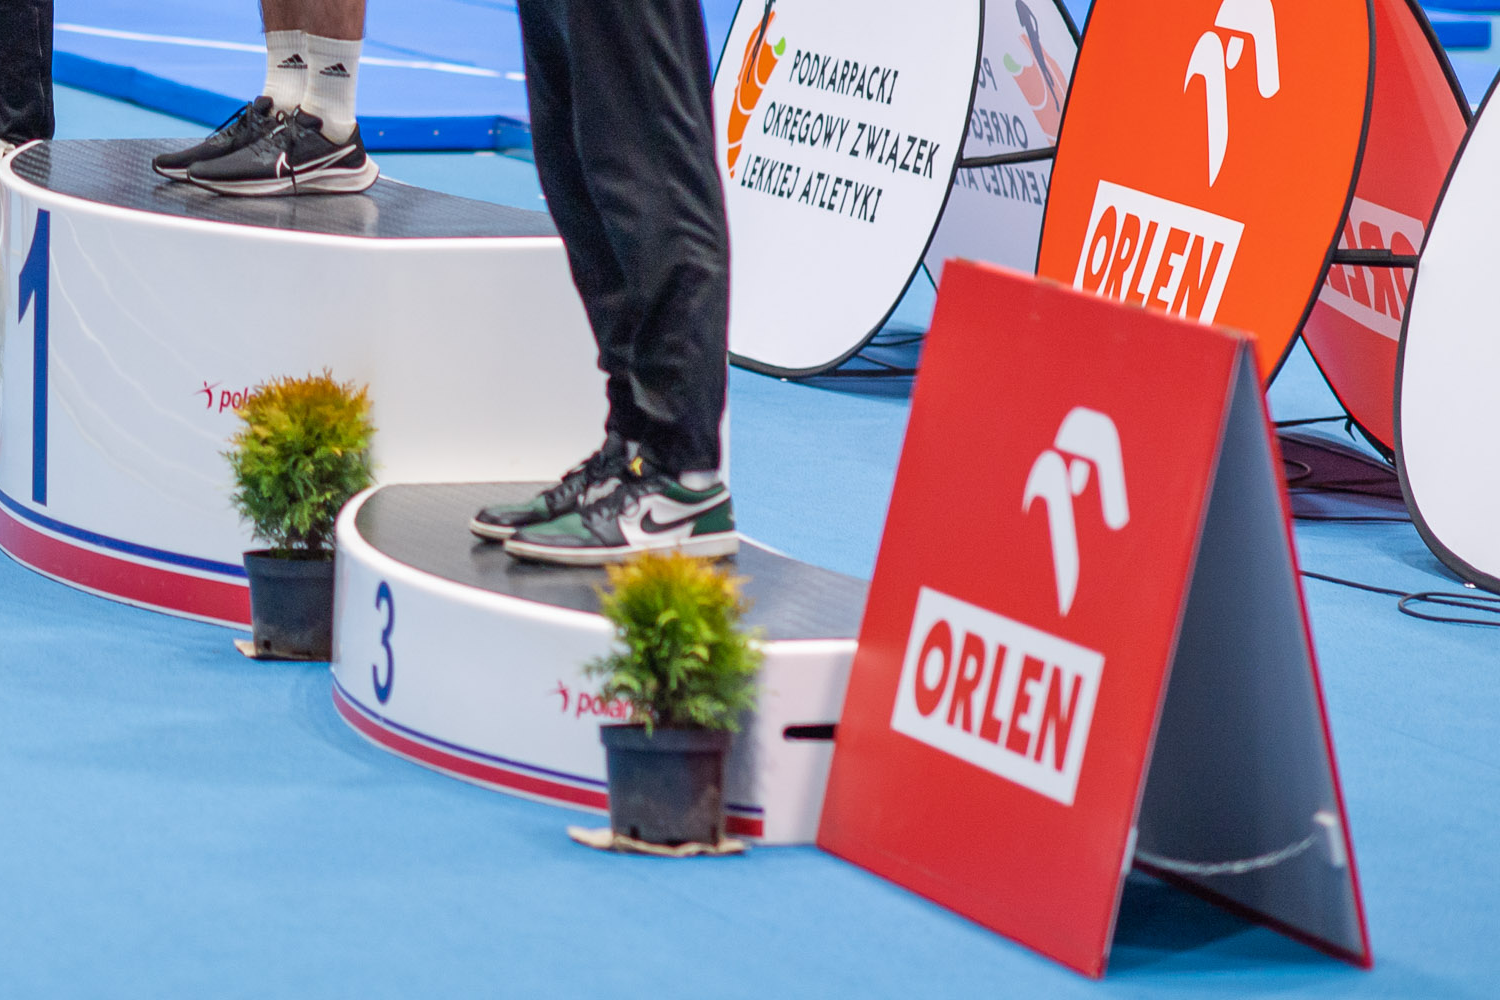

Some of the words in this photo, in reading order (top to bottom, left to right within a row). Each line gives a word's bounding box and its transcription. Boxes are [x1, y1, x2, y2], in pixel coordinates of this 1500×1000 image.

[789, 49, 899, 105] PODKARPACKI
[741, 153, 801, 199] LEKKIEJ
[798, 170, 883, 223] ATLETYKI
[763, 101, 850, 152] OKRĘGOWY
[849, 122, 940, 179] ZWIĄZEK
[1082, 205, 1225, 322] ORLEN
[18, 209, 51, 506] 1
[372, 580, 396, 705] 3
[914, 618, 1083, 773] ORLEN
